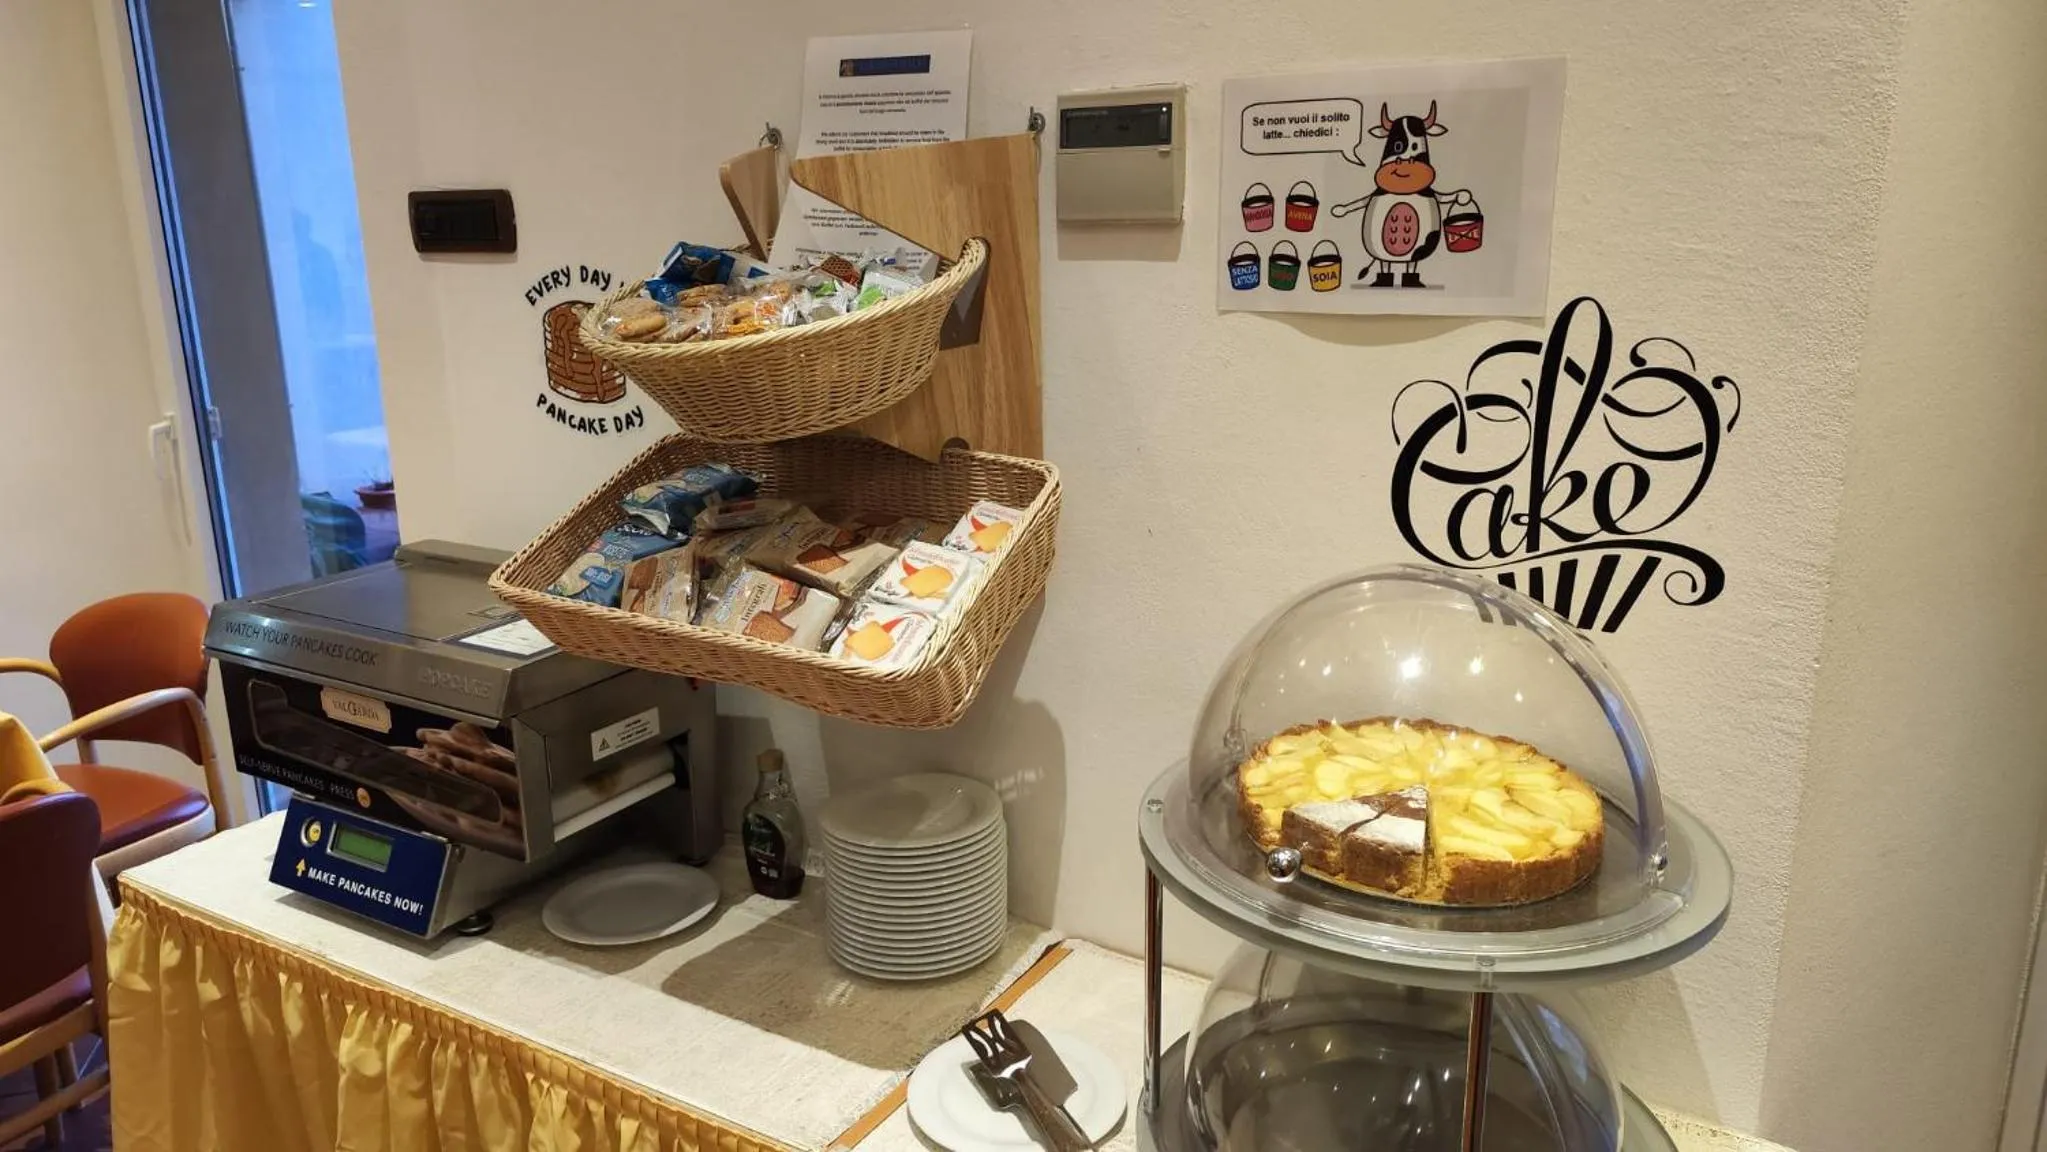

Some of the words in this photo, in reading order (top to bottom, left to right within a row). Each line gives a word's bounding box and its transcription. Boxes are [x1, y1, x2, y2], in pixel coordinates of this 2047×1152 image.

[1252, 116, 1265, 127] Se
[1267, 116, 1286, 126] non
[1288, 114, 1310, 124] vuoi
[1312, 113, 1318, 123] il
[1320, 112, 1351, 122] solito
[1293, 127, 1333, 138] chiedici
[1232, 265, 1258, 275] SENZA
[1312, 271, 1338, 283] SOIA
[525, 265, 571, 306] EVERY
[580, 265, 611, 291] DAY
[536, 393, 608, 436] PANCAKE
[613, 405, 645, 433] DAY
[1391, 296, 1740, 580] Cake
[226, 621, 260, 638] WATCH
[262, 628, 289, 646] YOUR
[290, 635, 344, 659] PANCAKES
[345, 647, 380, 666] COOK
[330, 783, 356, 801] PRESS
[307, 866, 337, 886] MAKE
[338, 876, 392, 905] PANCAKES
[393, 895, 424, 916] NOW!
